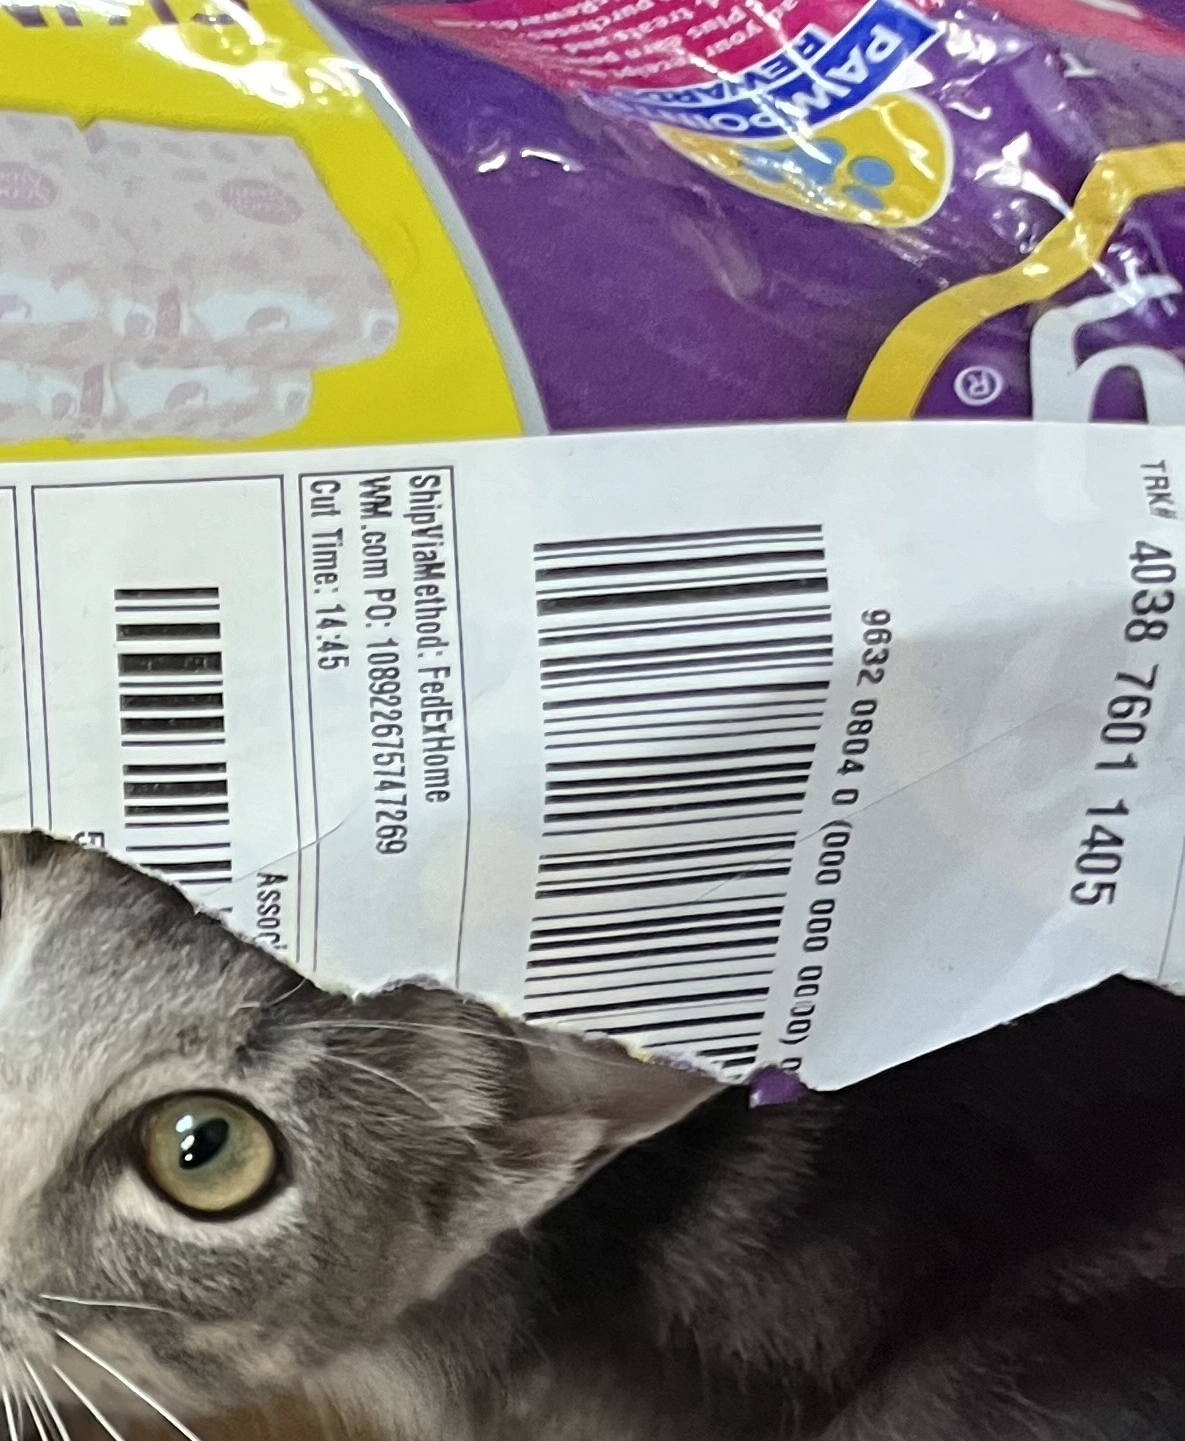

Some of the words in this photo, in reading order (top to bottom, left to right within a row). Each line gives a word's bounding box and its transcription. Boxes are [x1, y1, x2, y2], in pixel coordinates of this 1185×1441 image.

[309, 479, 342, 517] Cut
[358, 475, 393, 580] WM.com
[1140, 457, 1181, 522] TRK#
[311, 527, 345, 595] Time:
[403, 473, 450, 659] ShipViaMethod:
[1124, 539, 1178, 644] 4038
[314, 602, 350, 671] 14:45
[363, 587, 398, 629] PO:
[859, 607, 893, 688] 9632
[366, 637, 408, 855] 108922675747269
[417, 665, 452, 804] FedExHome
[836, 697, 878, 777] 0804
[1094, 662, 1161, 772] 7601
[831, 787, 861, 807] 0
[818, 818, 853, 887] (000
[1070, 797, 1131, 907] 1405
[803, 897, 836, 954] 000
